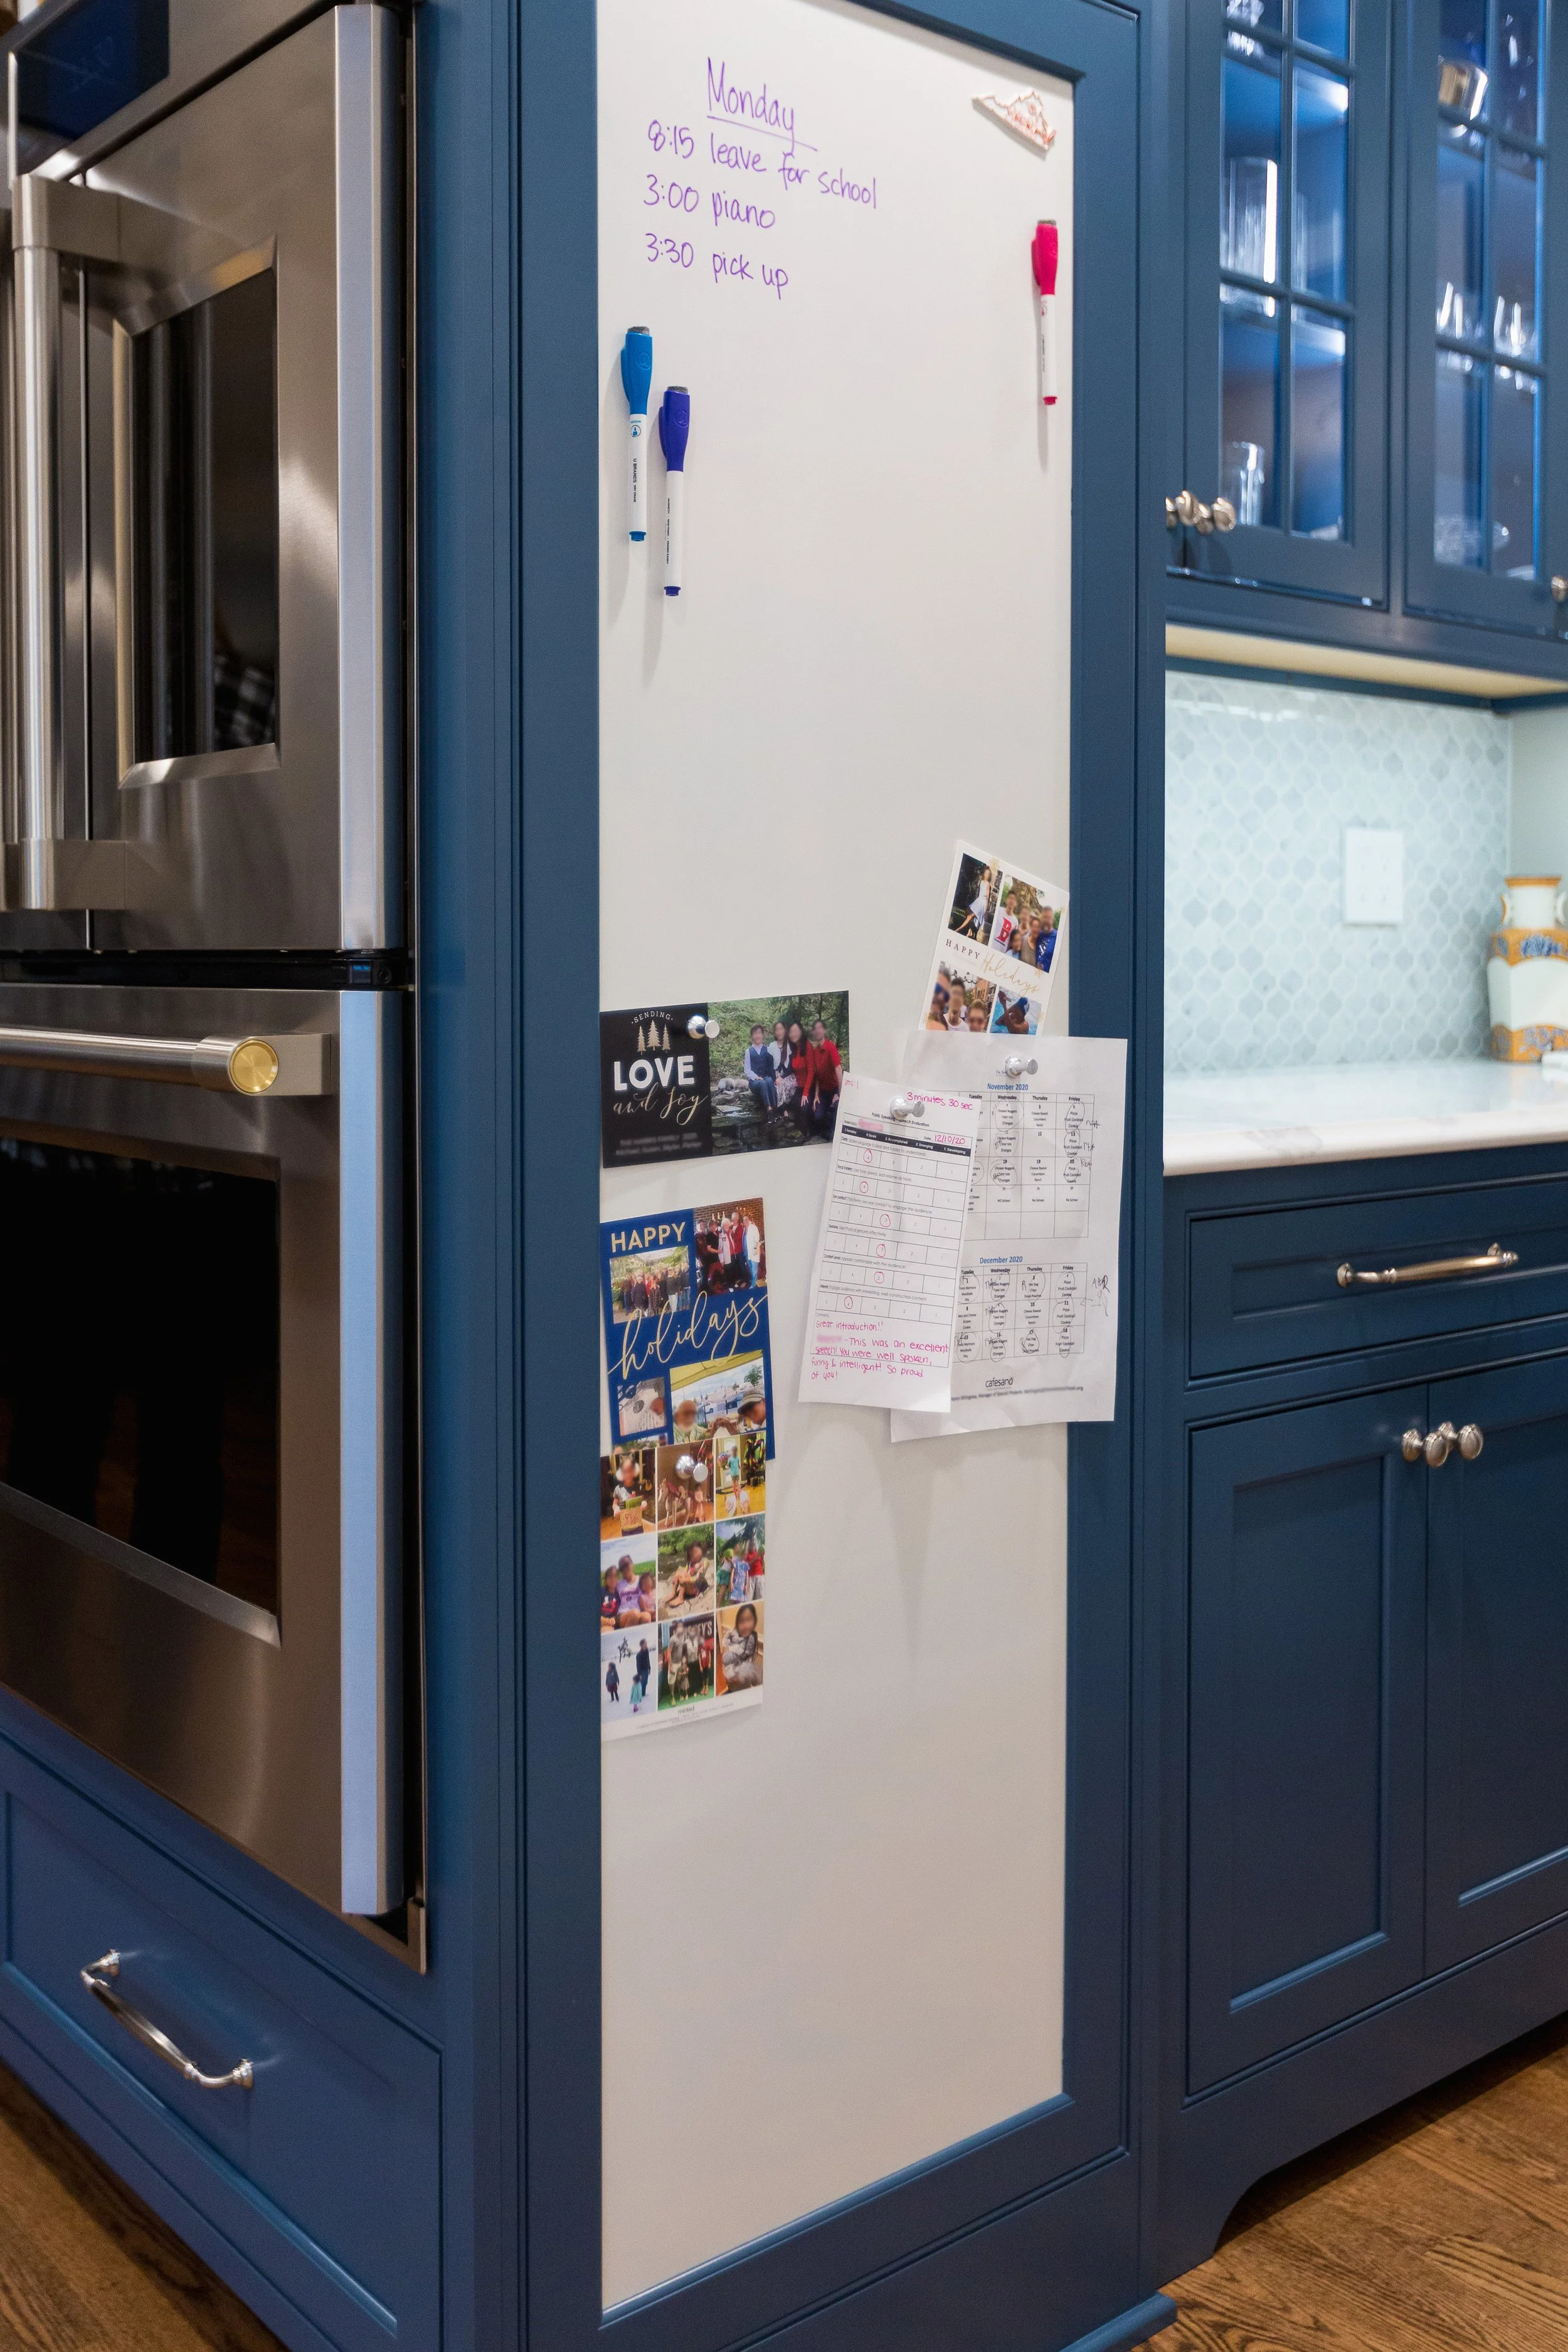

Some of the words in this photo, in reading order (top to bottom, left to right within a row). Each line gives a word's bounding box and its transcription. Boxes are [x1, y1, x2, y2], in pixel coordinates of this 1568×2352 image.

[707, 56, 794, 152] Monday
[648, 119, 694, 159] 8:15
[711, 132, 766, 172] leave
[778, 151, 810, 190] for
[818, 168, 876, 209] school
[644, 174, 699, 213] 3:00
[712, 191, 775, 228] piano
[645, 233, 694, 268] 3:30
[713, 252, 753, 283] pick
[763, 264, 788, 300] up
[945, 938, 980, 959] HAPPY
[980, 952, 1039, 997] Holidays
[633, 1010, 671, 1023] SENDING
[613, 1056, 694, 1092] LOVE
[613, 1082, 659, 1115] and
[948, 1099, 958, 1108] 30
[961, 1102, 973, 1110] sec
[935, 1135, 966, 1144] 12/10/20
[611, 1221, 686, 1253] HAPPY
[607, 1291, 768, 1380] holidays
[815, 1320, 834, 1328] Great
[849, 1337, 866, 1347] This
[872, 1339, 889, 1348] was
[894, 1339, 905, 1348] an
[909, 1342, 948, 1353] excellent
[811, 1357, 829, 1369] funny
[839, 1359, 881, 1374] intelligent!
[887, 1365, 896, 1374] So
[901, 1368, 923, 1377] proud
[877, 1352, 894, 1360] well
[899, 1353, 932, 1365] spoken,
[823, 1371, 838, 1380] you!
[985, 1377, 1014, 1388] cafesano
